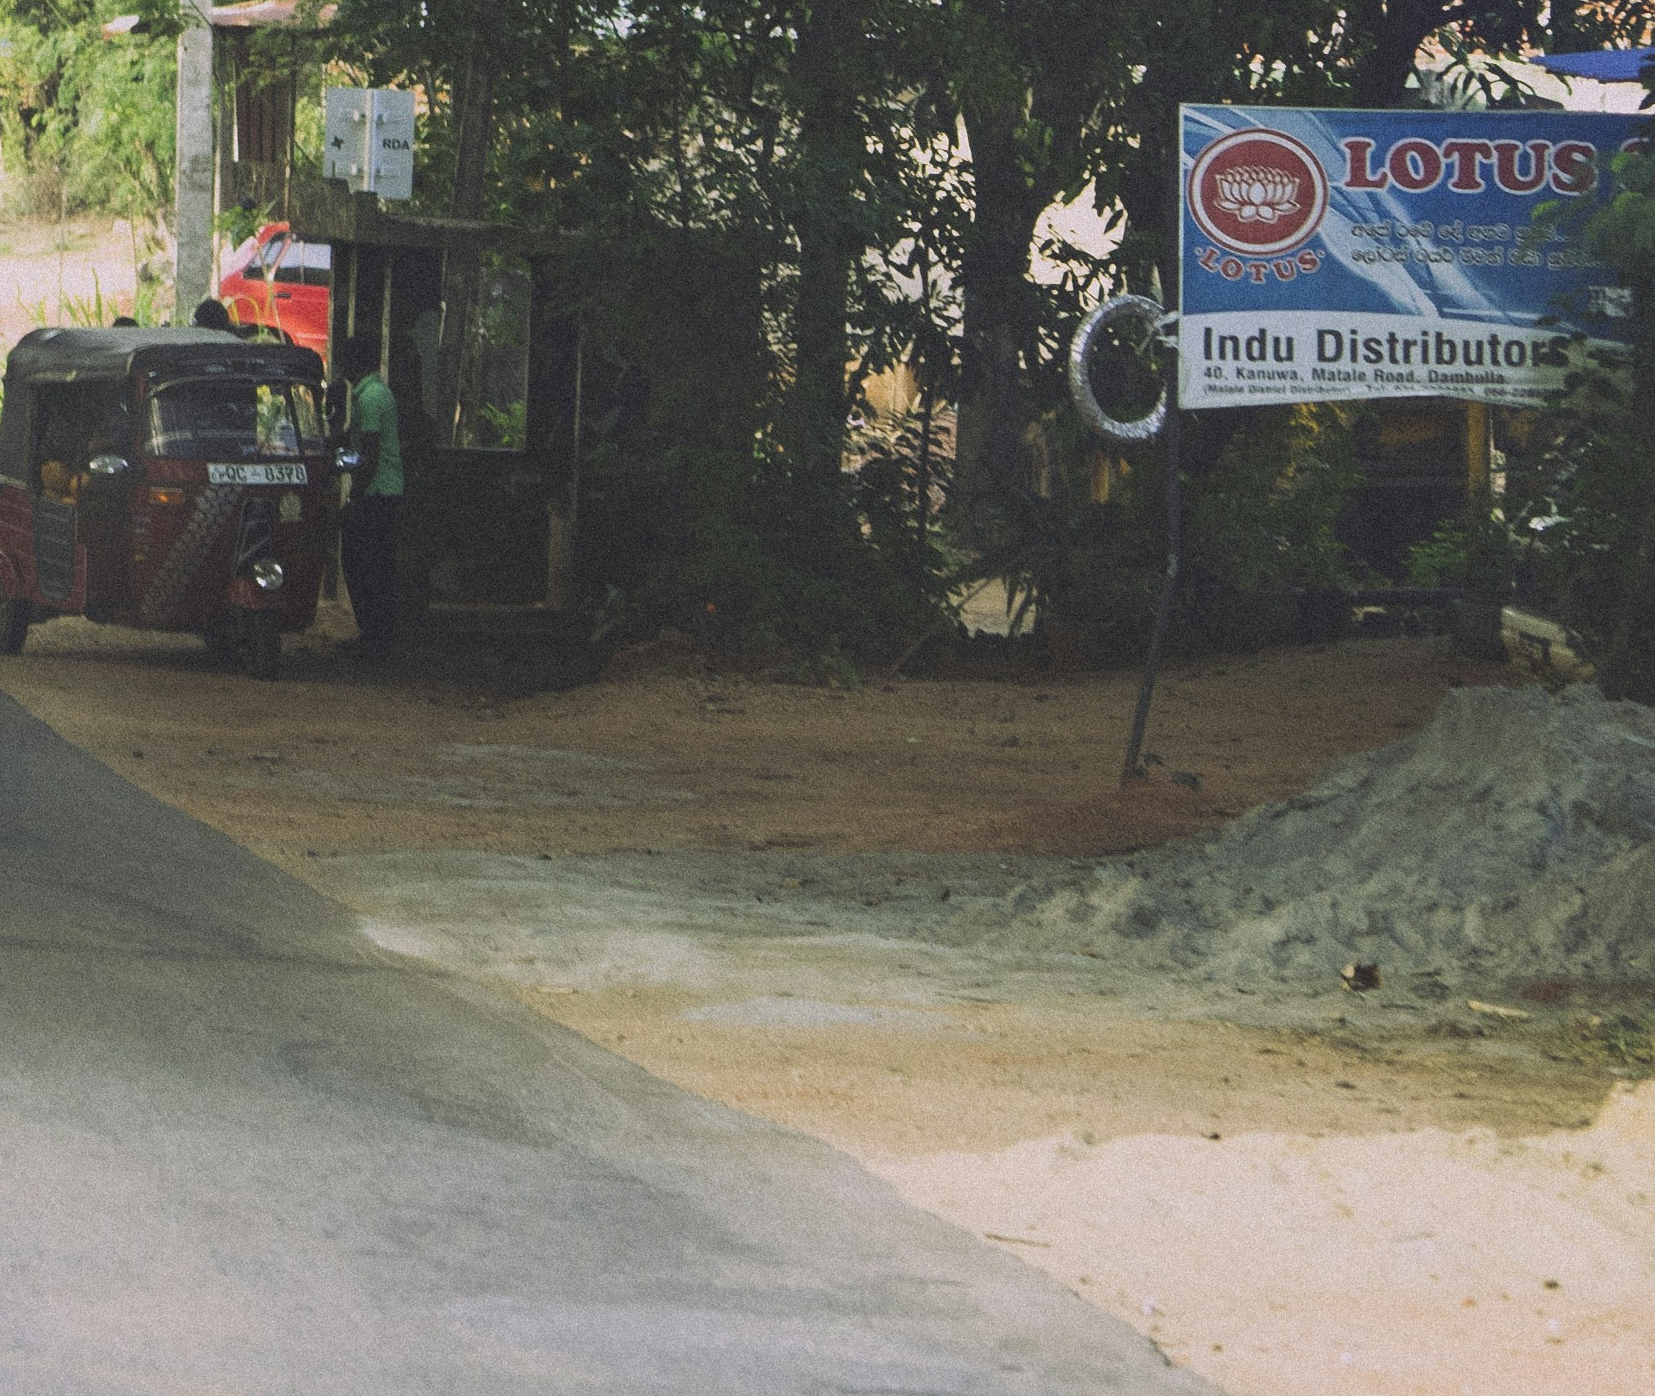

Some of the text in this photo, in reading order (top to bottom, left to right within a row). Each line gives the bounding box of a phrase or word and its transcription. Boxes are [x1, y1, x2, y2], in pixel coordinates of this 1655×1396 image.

[382, 138, 410, 151] RDA
[1343, 137, 1598, 195] LOTUS
[1198, 246, 1321, 284] LOTUS
[1203, 326, 1569, 368] Indu Distributors
[1311, 366, 1367, 383] Matale
[226, 464, 247, 483] QC
